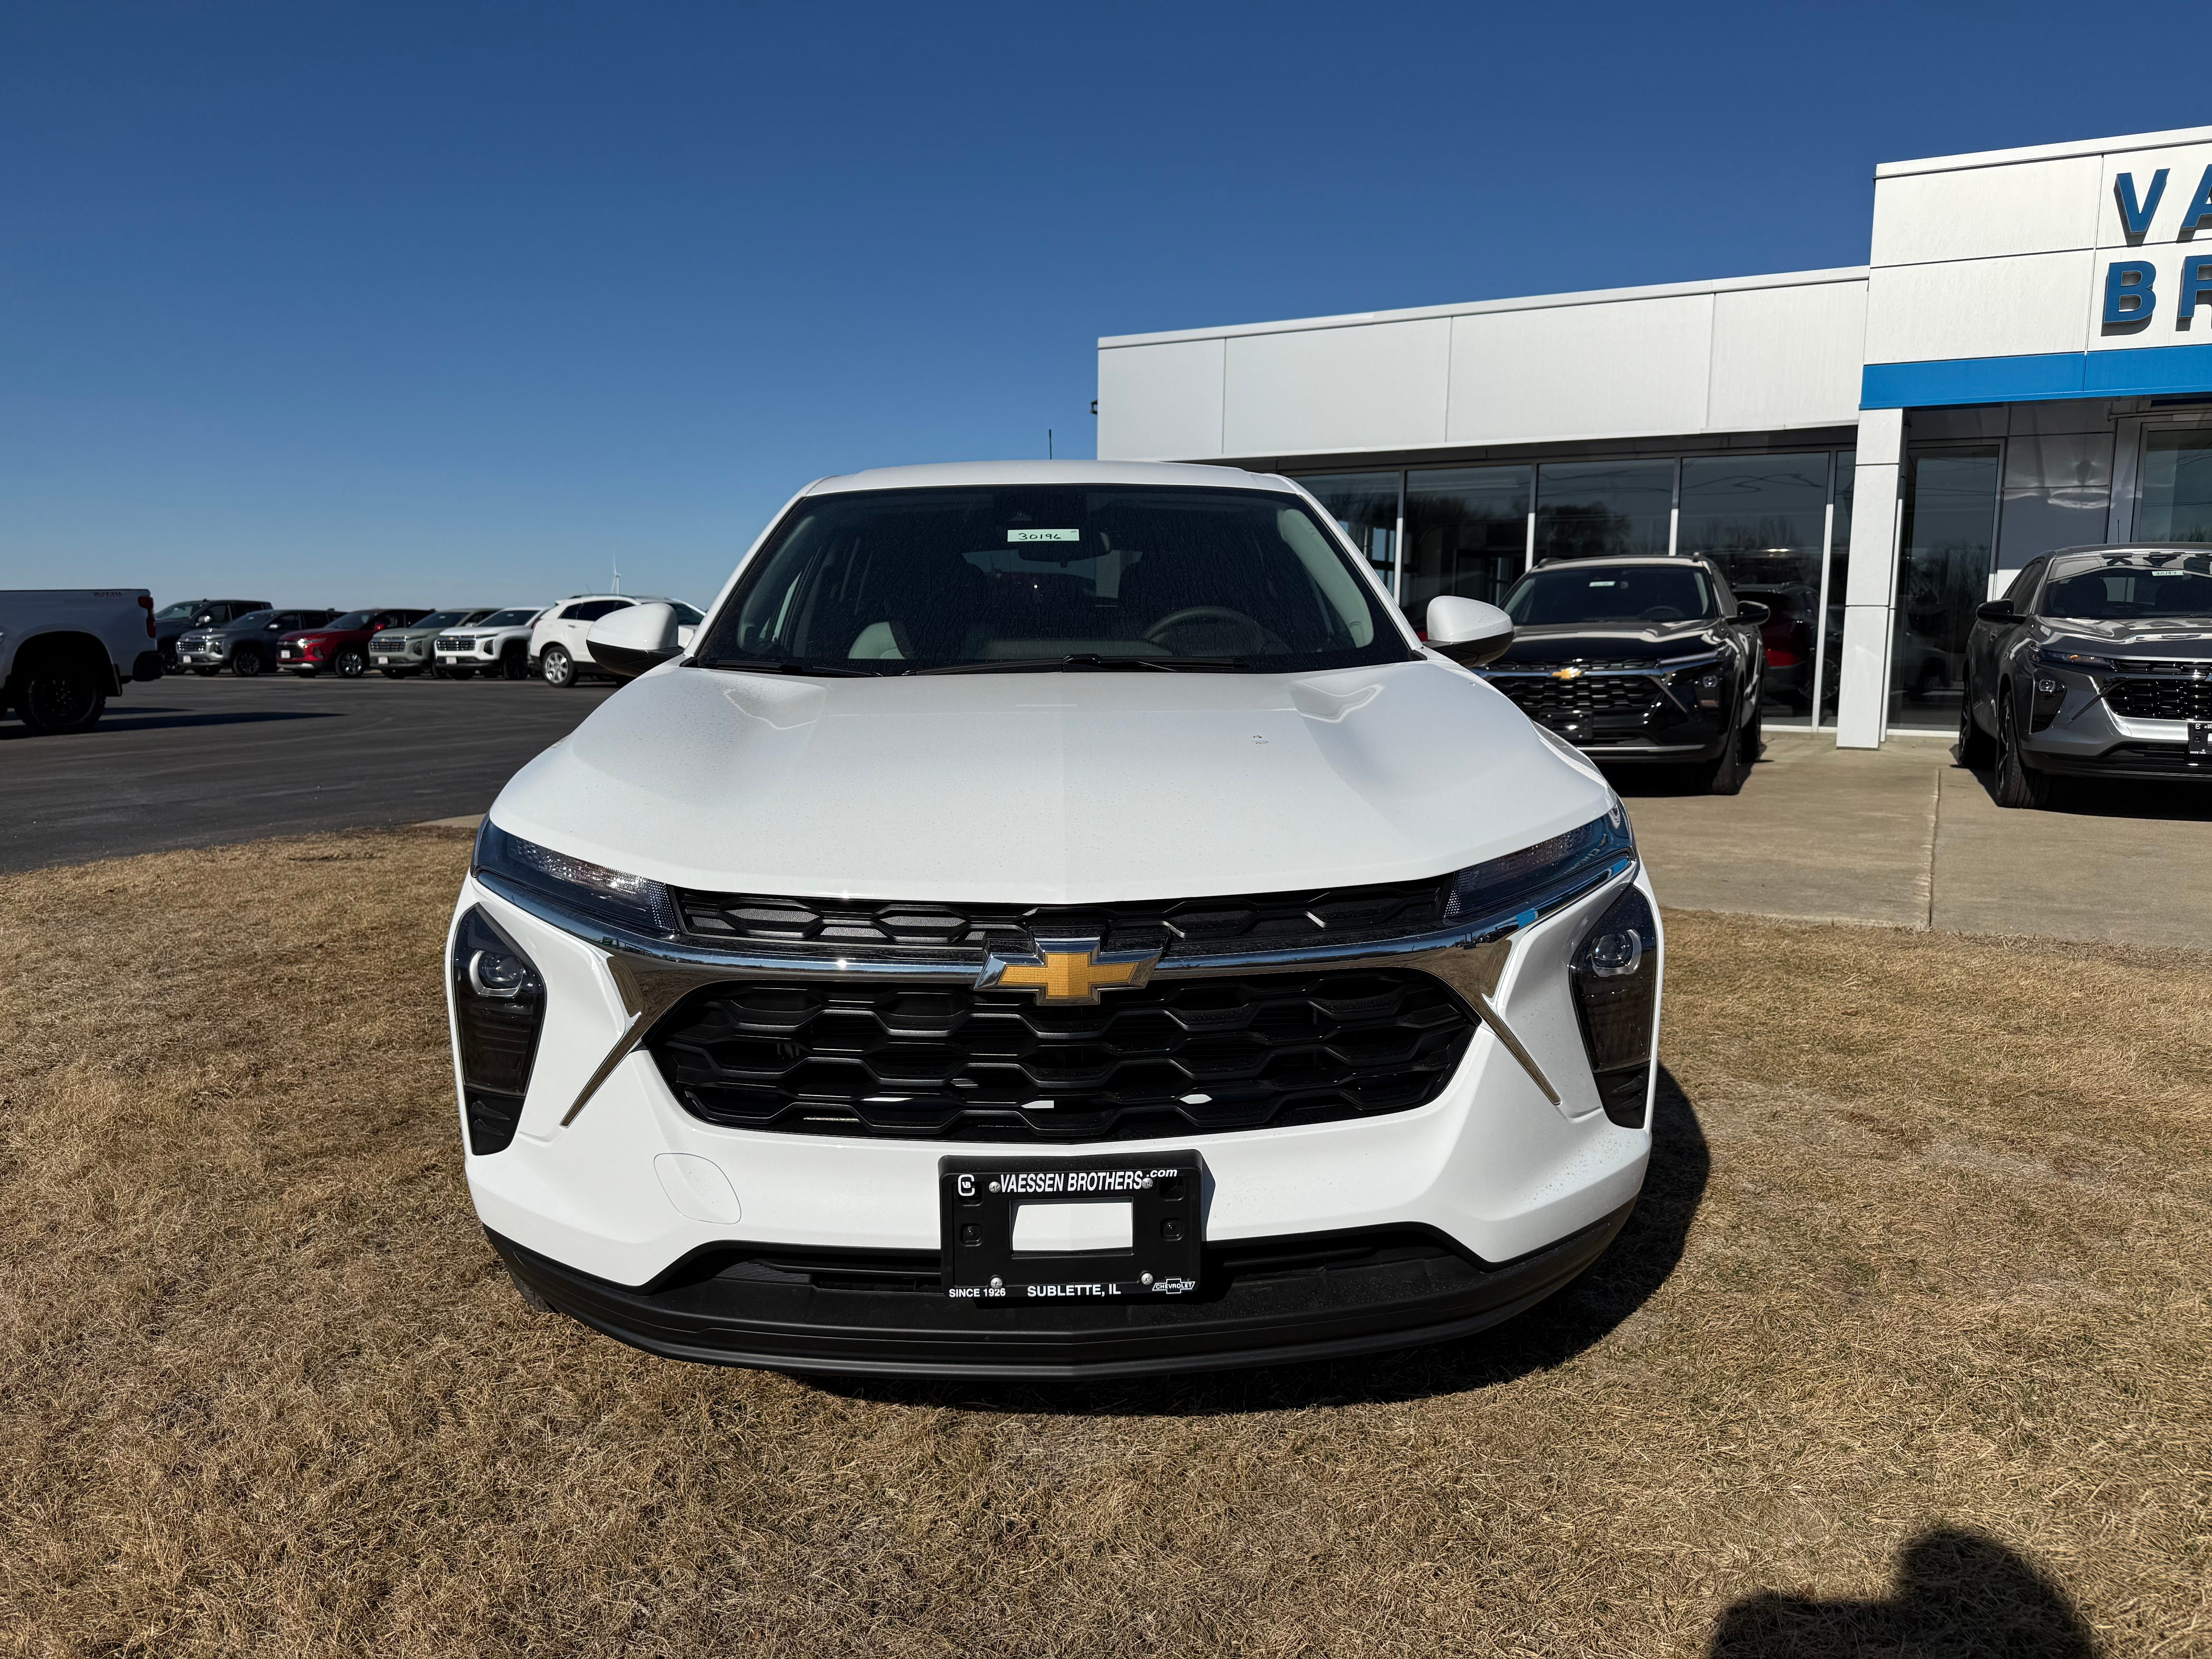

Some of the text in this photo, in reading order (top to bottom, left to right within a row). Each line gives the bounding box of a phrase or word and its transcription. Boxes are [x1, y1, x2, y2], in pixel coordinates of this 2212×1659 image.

[1000, 1169, 1178, 1193] VAESSEN BROTHERS .com
[948, 1287, 1006, 1297] SINCE 1926
[1027, 1283, 1121, 1297] SUBLETTE, IL
